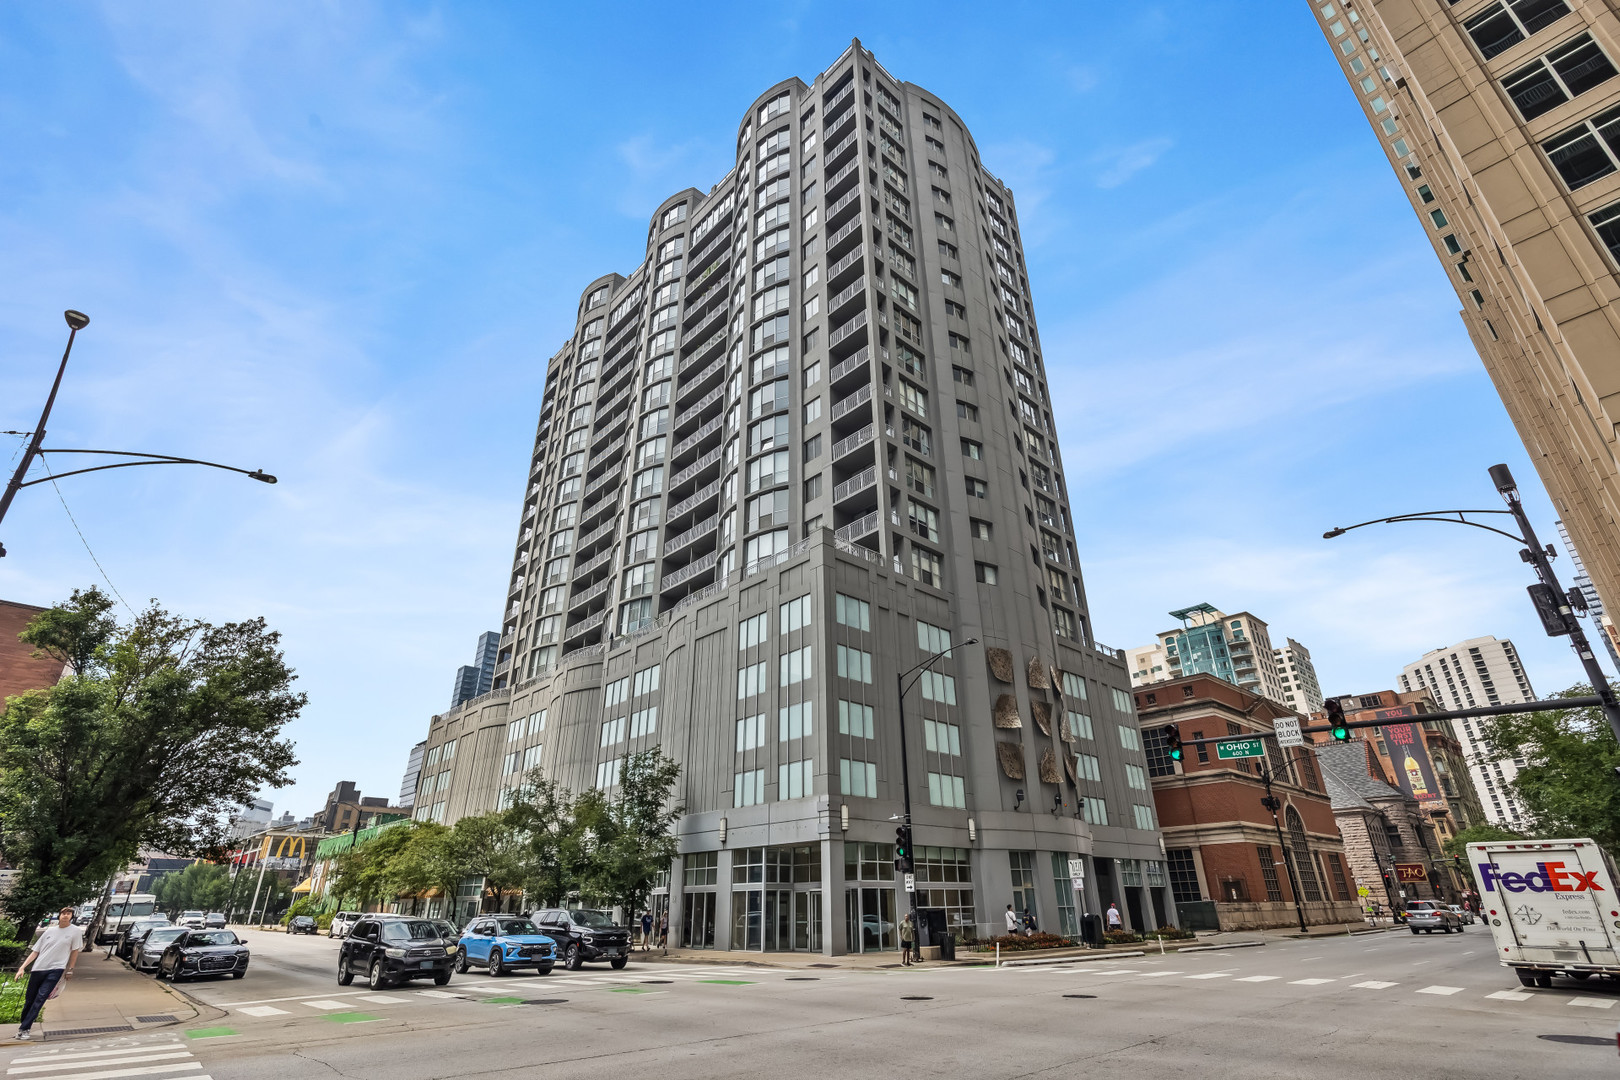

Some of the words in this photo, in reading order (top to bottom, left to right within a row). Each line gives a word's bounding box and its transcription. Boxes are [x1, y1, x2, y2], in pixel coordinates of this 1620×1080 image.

[1385, 709, 1402, 718] YOU
[1285, 720, 1298, 728] NOT
[1278, 730, 1300, 738] BLOCK
[1388, 726, 1411, 734] YOUR
[1390, 732, 1413, 740] FIRST
[1393, 738, 1414, 746] TIME
[1226, 742, 1250, 751] OHIO
[1398, 868, 1424, 878] TAO
[1478, 862, 1605, 893] FedEx
[1555, 892, 1585, 901] Express
